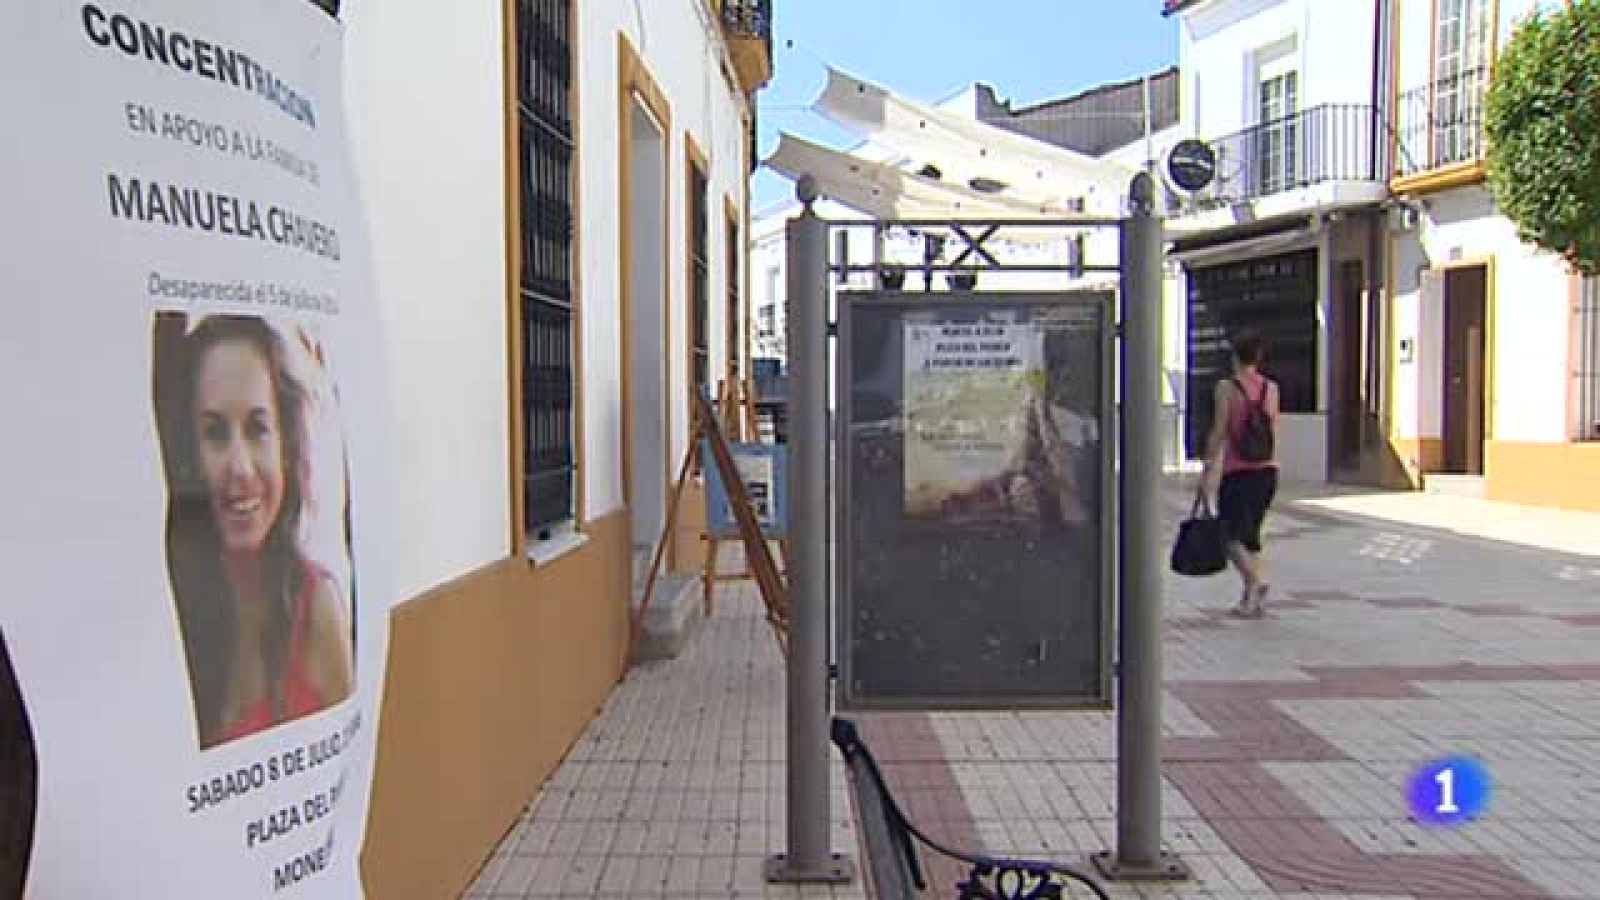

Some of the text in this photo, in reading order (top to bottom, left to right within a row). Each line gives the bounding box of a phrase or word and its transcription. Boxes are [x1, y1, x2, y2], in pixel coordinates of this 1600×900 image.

[125, 102, 157, 133] EN
[162, 112, 228, 151] APOYO
[231, 130, 247, 157] A
[247, 135, 267, 160] LA
[107, 172, 266, 241] MANUELA
[186, 761, 264, 814] SABADO
[282, 747, 306, 777] DE
[247, 803, 301, 849] PLAZA
